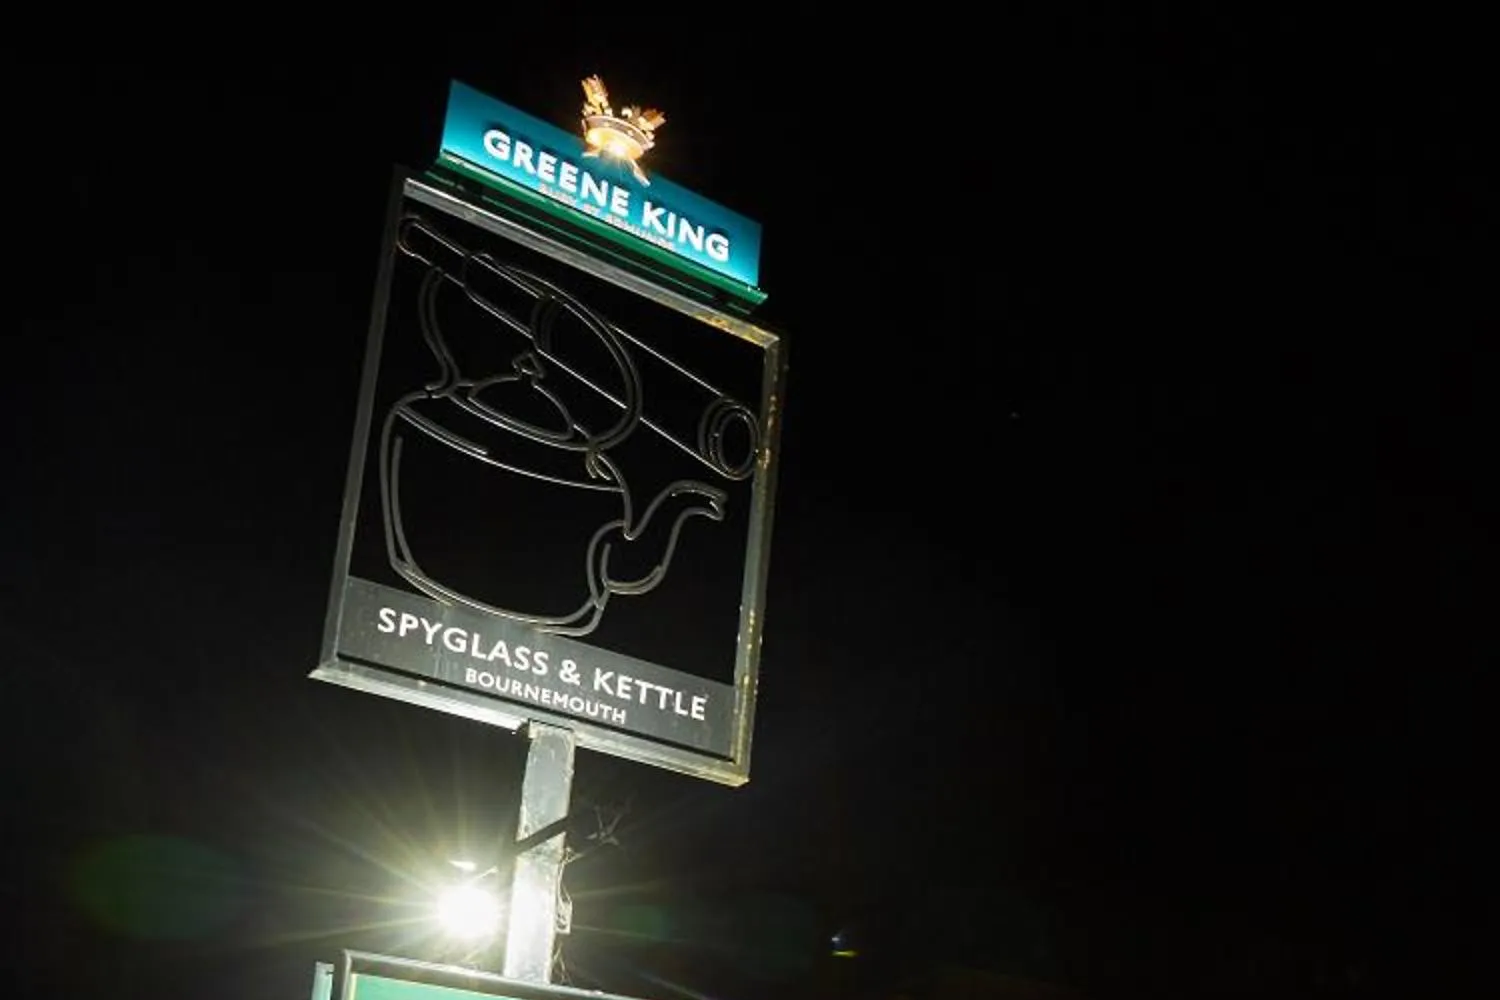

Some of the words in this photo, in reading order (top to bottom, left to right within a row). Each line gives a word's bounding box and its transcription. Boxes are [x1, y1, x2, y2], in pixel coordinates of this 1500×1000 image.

[482, 129, 631, 217] GREENE
[641, 201, 730, 262] KING
[377, 607, 550, 676] SPYGLASS
[558, 659, 581, 686] &
[593, 667, 707, 721] KETTLE
[465, 668, 627, 725] BOURNEMOUTH
